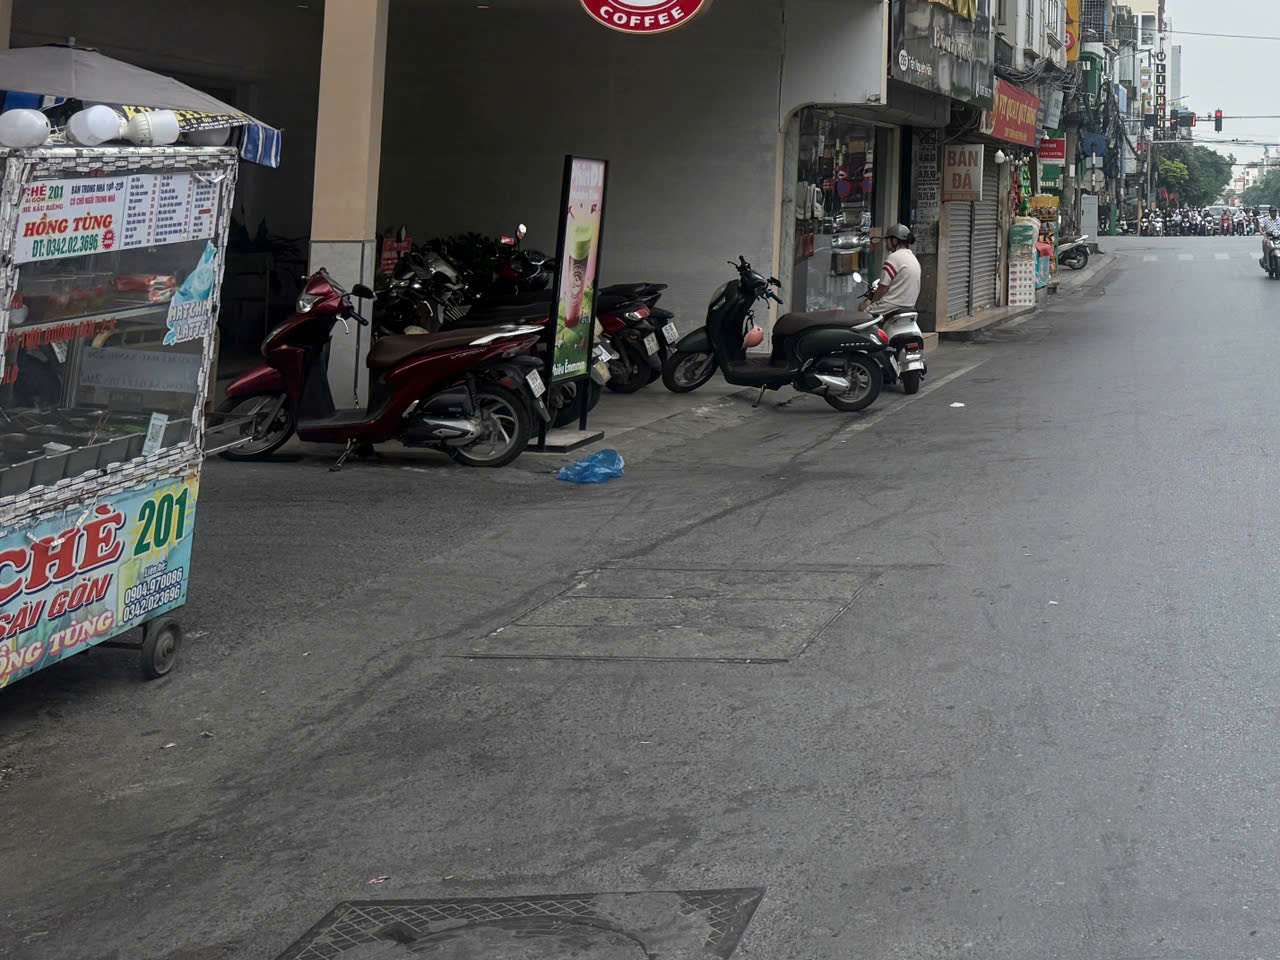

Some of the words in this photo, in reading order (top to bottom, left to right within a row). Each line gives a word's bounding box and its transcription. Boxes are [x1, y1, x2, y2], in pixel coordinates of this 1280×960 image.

[599, 5, 685, 27] COFFEE
[947, 147, 980, 168] BÁN
[952, 169, 973, 190] ĐÁ
[48, 184, 64, 199] 201
[23, 212, 68, 238] HỒNG
[73, 211, 113, 232] TÙNG
[46, 233, 99, 256] 0342.02.3696
[175, 319, 208, 339] LATTE
[133, 487, 189, 557] 201
[48, 572, 112, 621] GÒN
[49, 609, 116, 656] TÙNG
